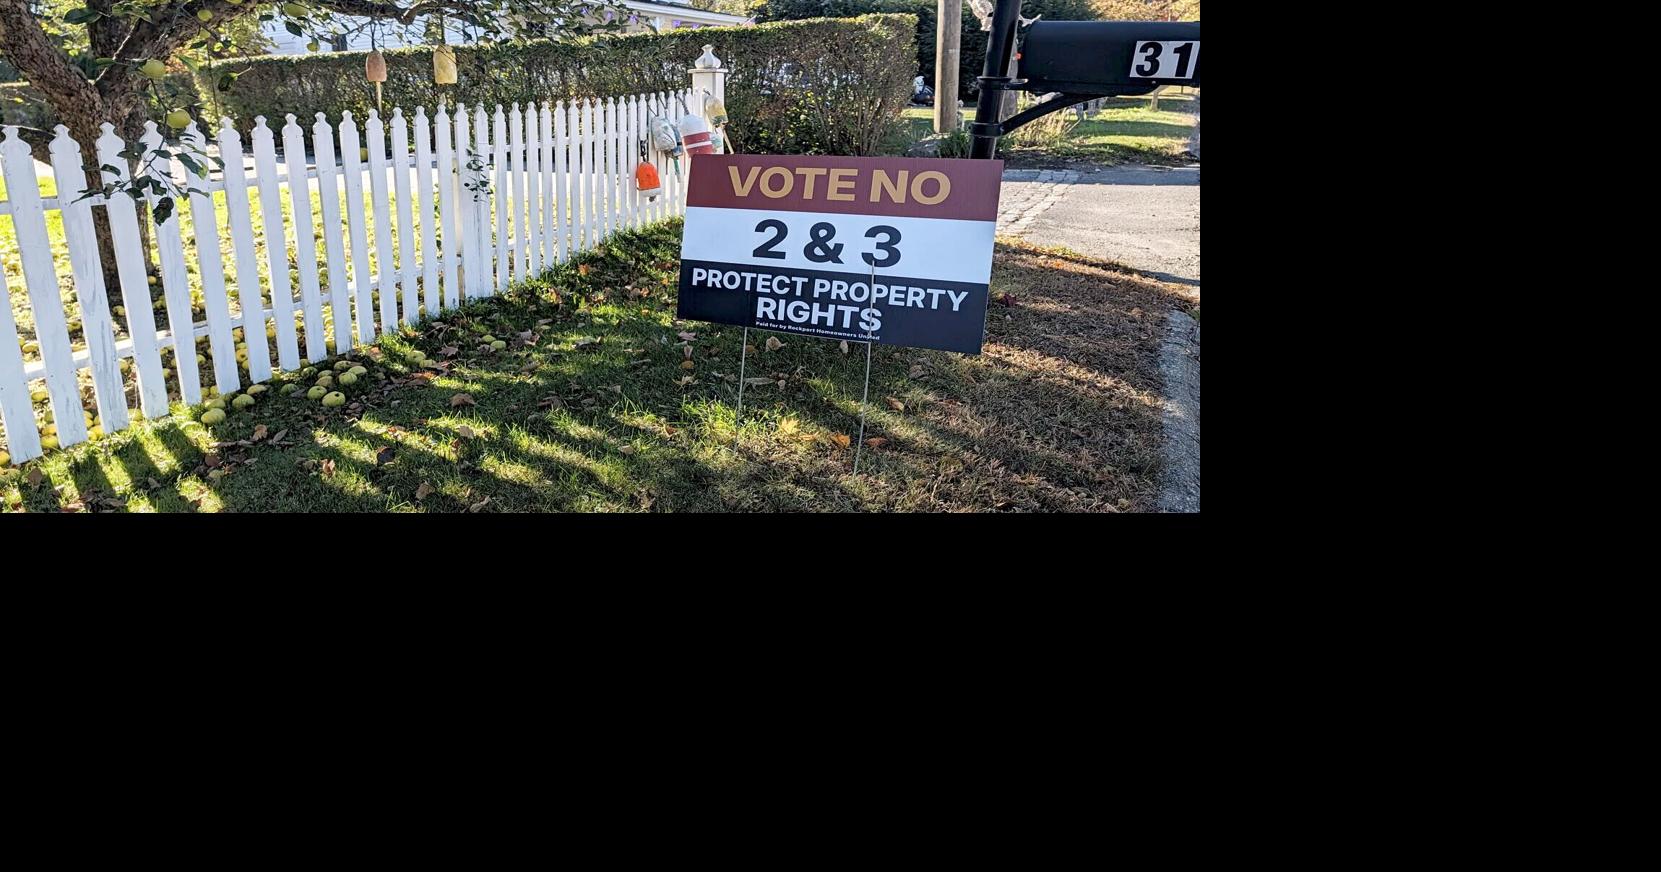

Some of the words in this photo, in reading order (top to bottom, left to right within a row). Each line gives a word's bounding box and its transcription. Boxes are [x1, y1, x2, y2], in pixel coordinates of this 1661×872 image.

[1135, 41, 1193, 77] 31
[728, 165, 859, 202] VOTE
[869, 169, 951, 205] NO
[752, 219, 788, 260] 2
[803, 222, 845, 265] &
[861, 225, 902, 268] 3
[691, 267, 809, 296] PROTECT
[812, 278, 968, 312] PROPERTY
[756, 296, 883, 332] RIGHTS
[788, 324, 815, 333] Rockport
[816, 328, 857, 338] Homeowners
